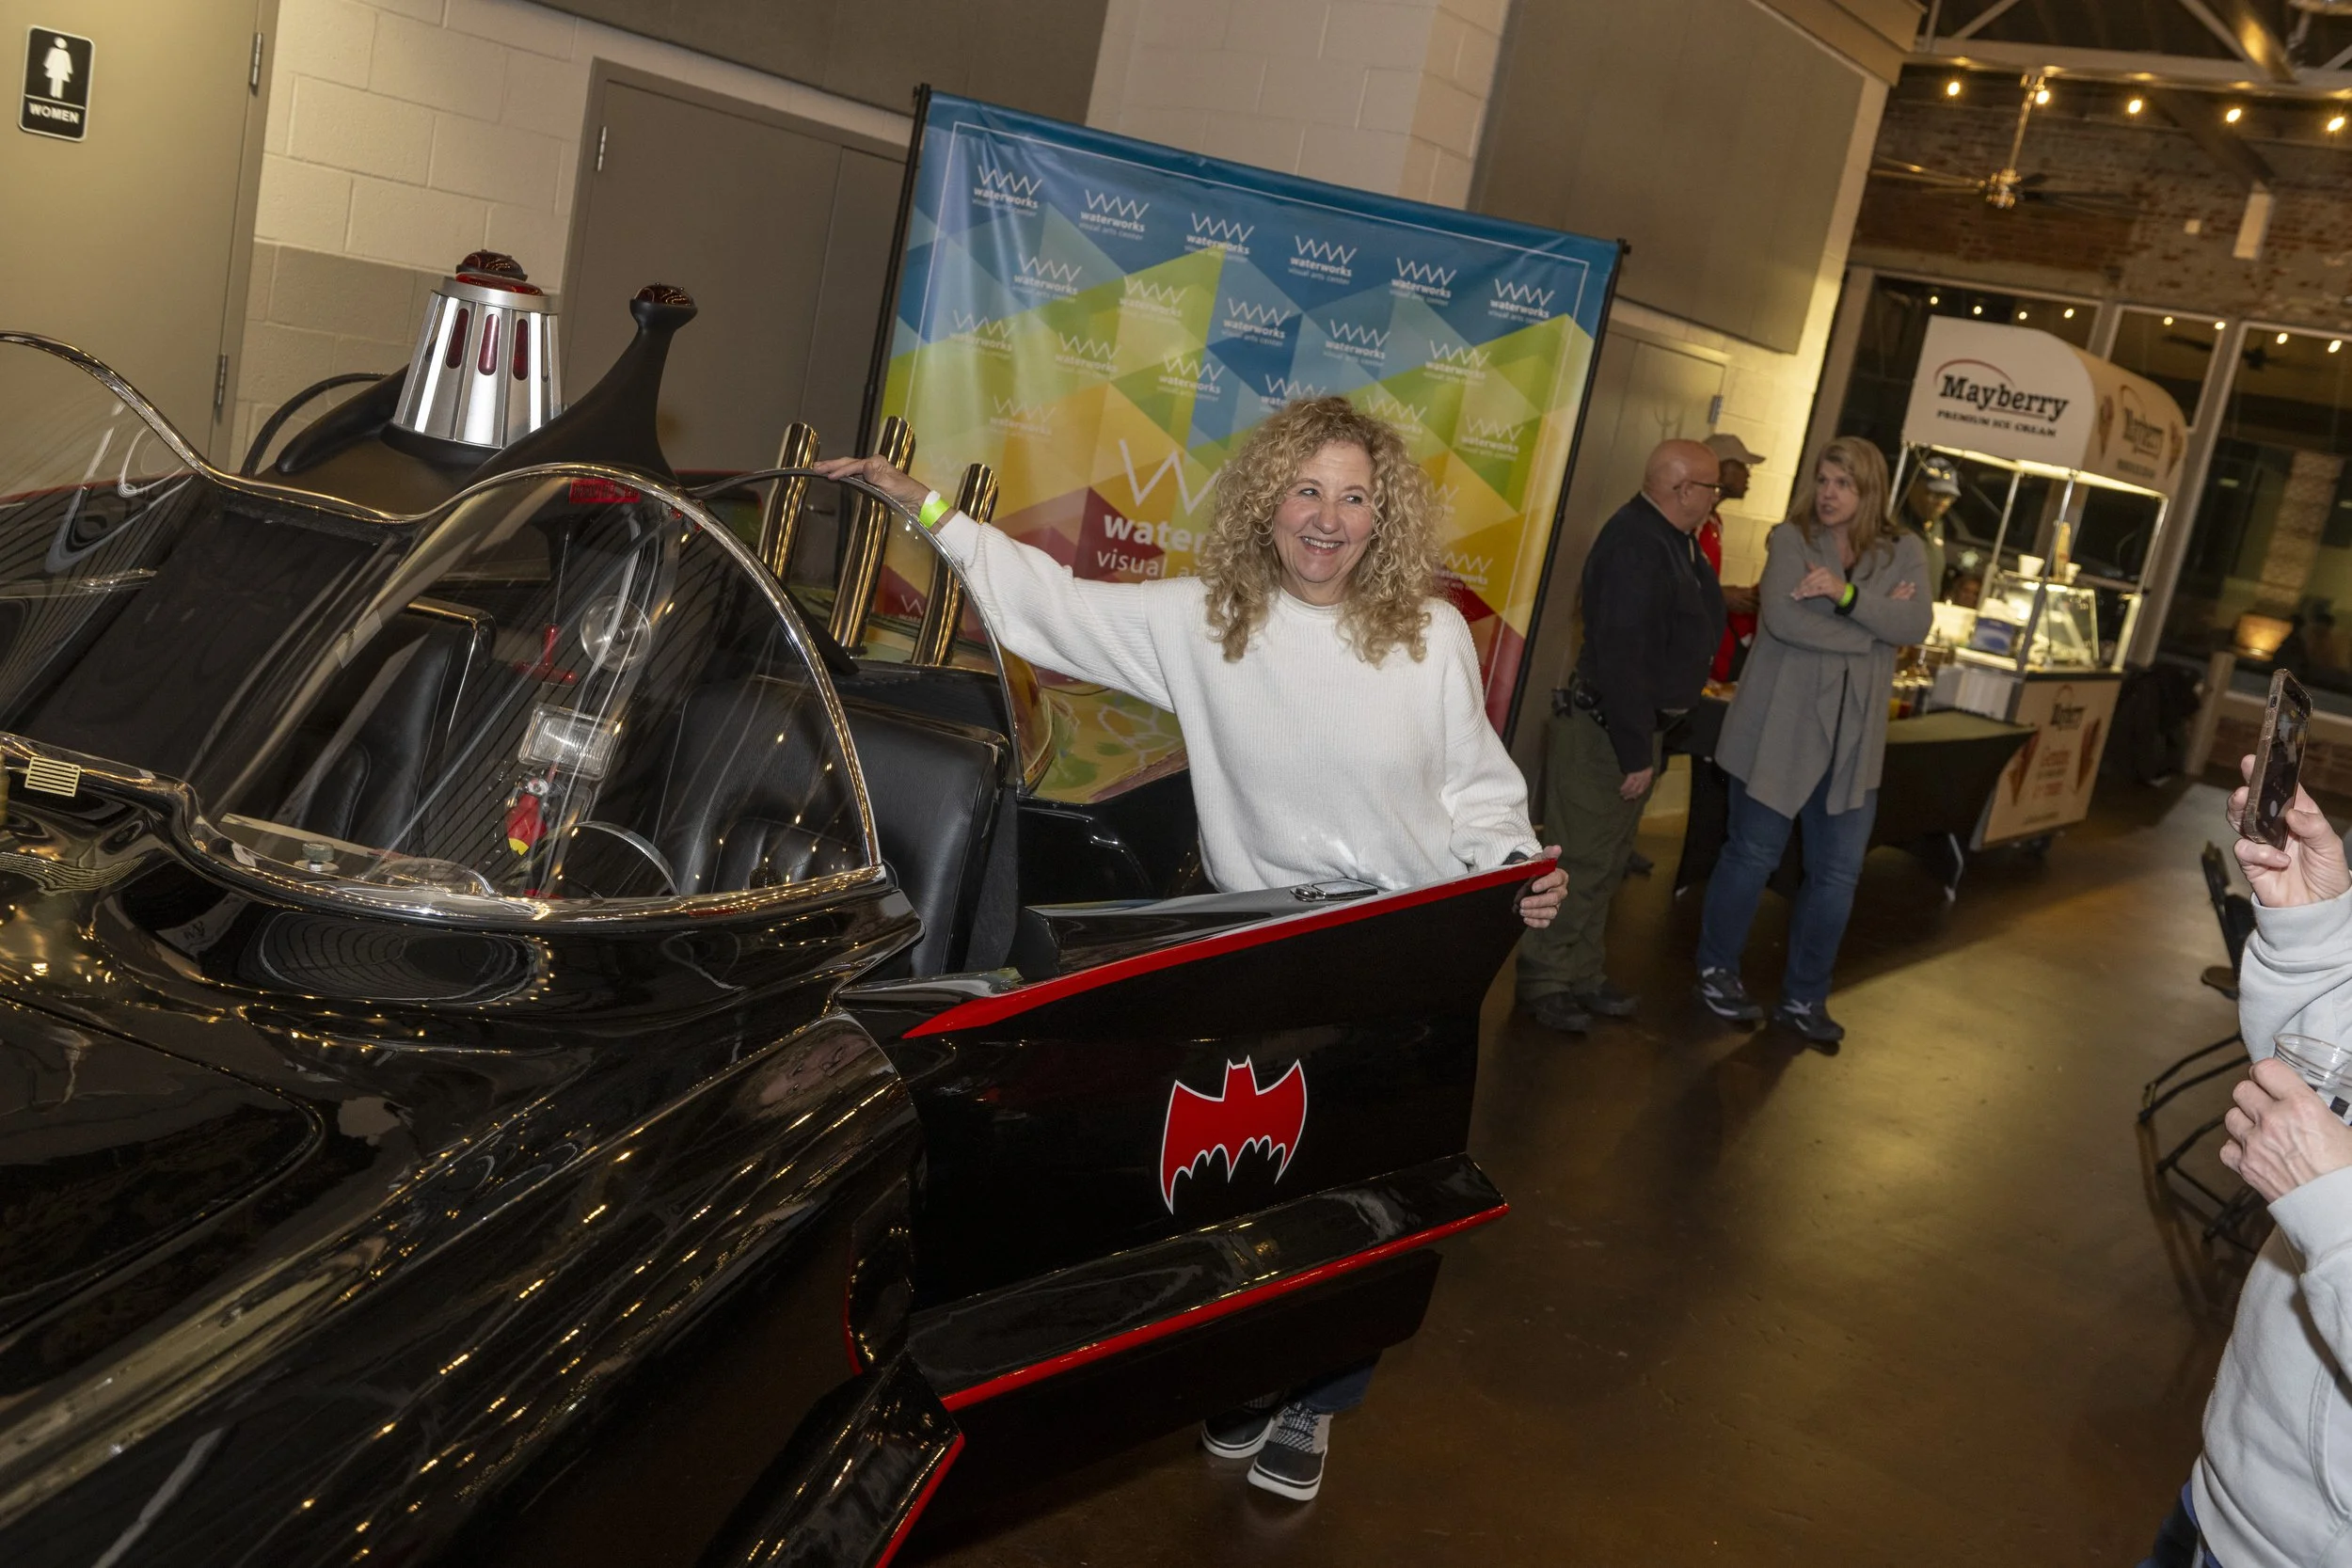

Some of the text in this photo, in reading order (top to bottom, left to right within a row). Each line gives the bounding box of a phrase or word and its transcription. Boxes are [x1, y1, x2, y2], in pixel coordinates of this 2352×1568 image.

[28, 102, 80, 124] WOMEN
[973, 188, 1038, 208] waterworks
[1080, 212, 1144, 231] waterworks
[1186, 235, 1248, 254] waterworks
[1288, 267, 1310, 277] visual
[1290, 257, 1351, 277] waterworks
[1013, 276, 1077, 295] waterworks
[1391, 278, 1451, 298] waterworks
[1120, 298, 1182, 317] waterworks
[1489, 300, 1549, 319] waterworks
[1223, 320, 1284, 339] waterworks
[949, 333, 1011, 352] waterworks
[1260, 337, 1283, 346] center
[1326, 341, 1385, 359] waterworks
[1056, 355, 1117, 373] waterworks
[1425, 361, 1485, 380] waterworks
[1159, 375, 1220, 394] waterworks
[1939, 374, 2070, 422] Mayberry
[1936, 409, 2058, 438] PREMIUM ICE CREAM
[1461, 436, 1518, 453] waterworks
[1104, 515, 1205, 554] water
[1097, 548, 1168, 578] visual
